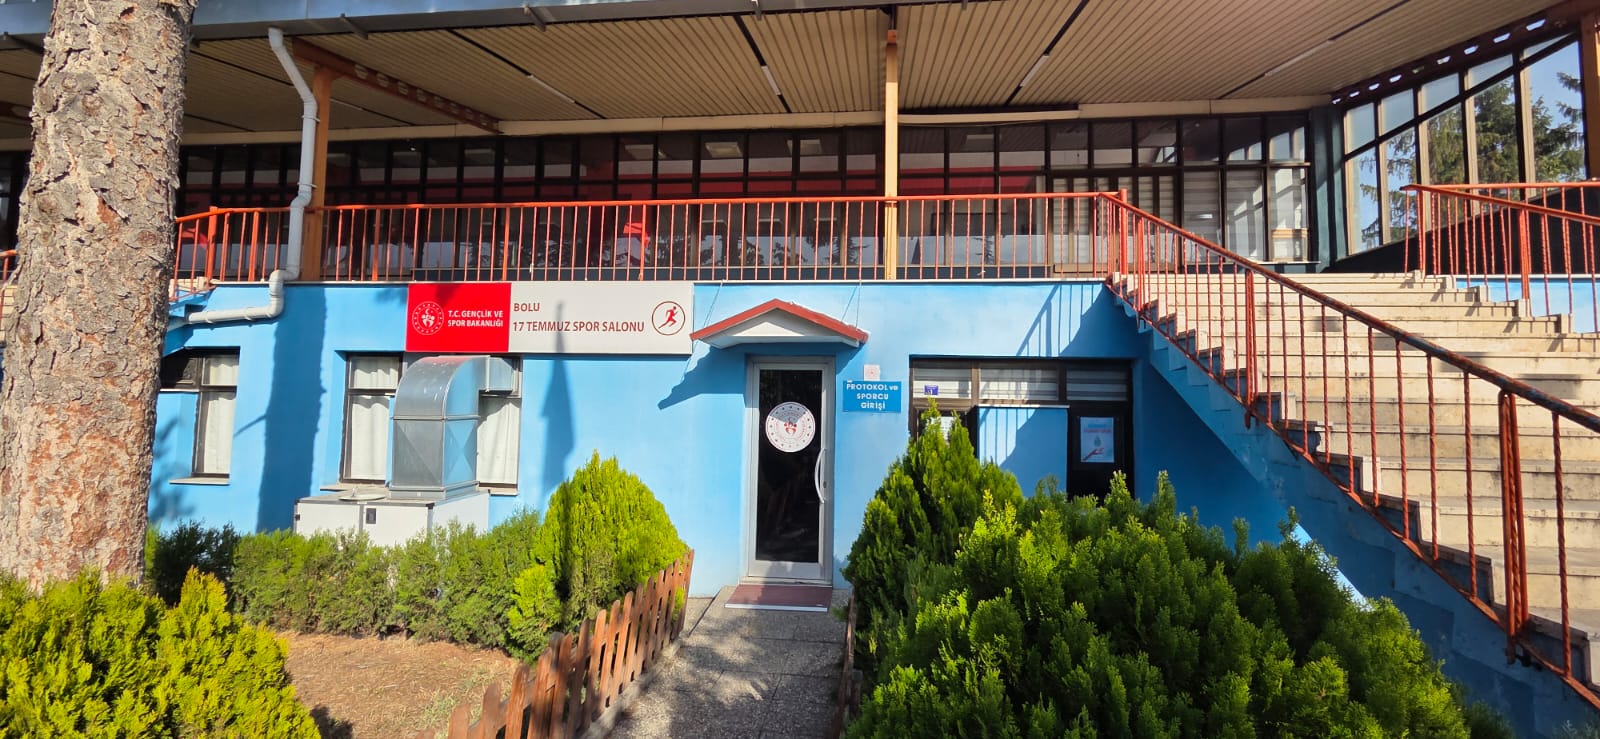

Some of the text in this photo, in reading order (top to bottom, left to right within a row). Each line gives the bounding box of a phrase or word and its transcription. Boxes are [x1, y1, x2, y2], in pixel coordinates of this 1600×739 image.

[514, 303, 540, 312] BOLU
[462, 310, 492, 319] GENÇLİK
[448, 318, 503, 327] SPOR BAKANLIĞI
[513, 322, 644, 332] 17 TEMMUZ SPOR SALONU
[860, 401, 886, 410] GİRİŞİ
